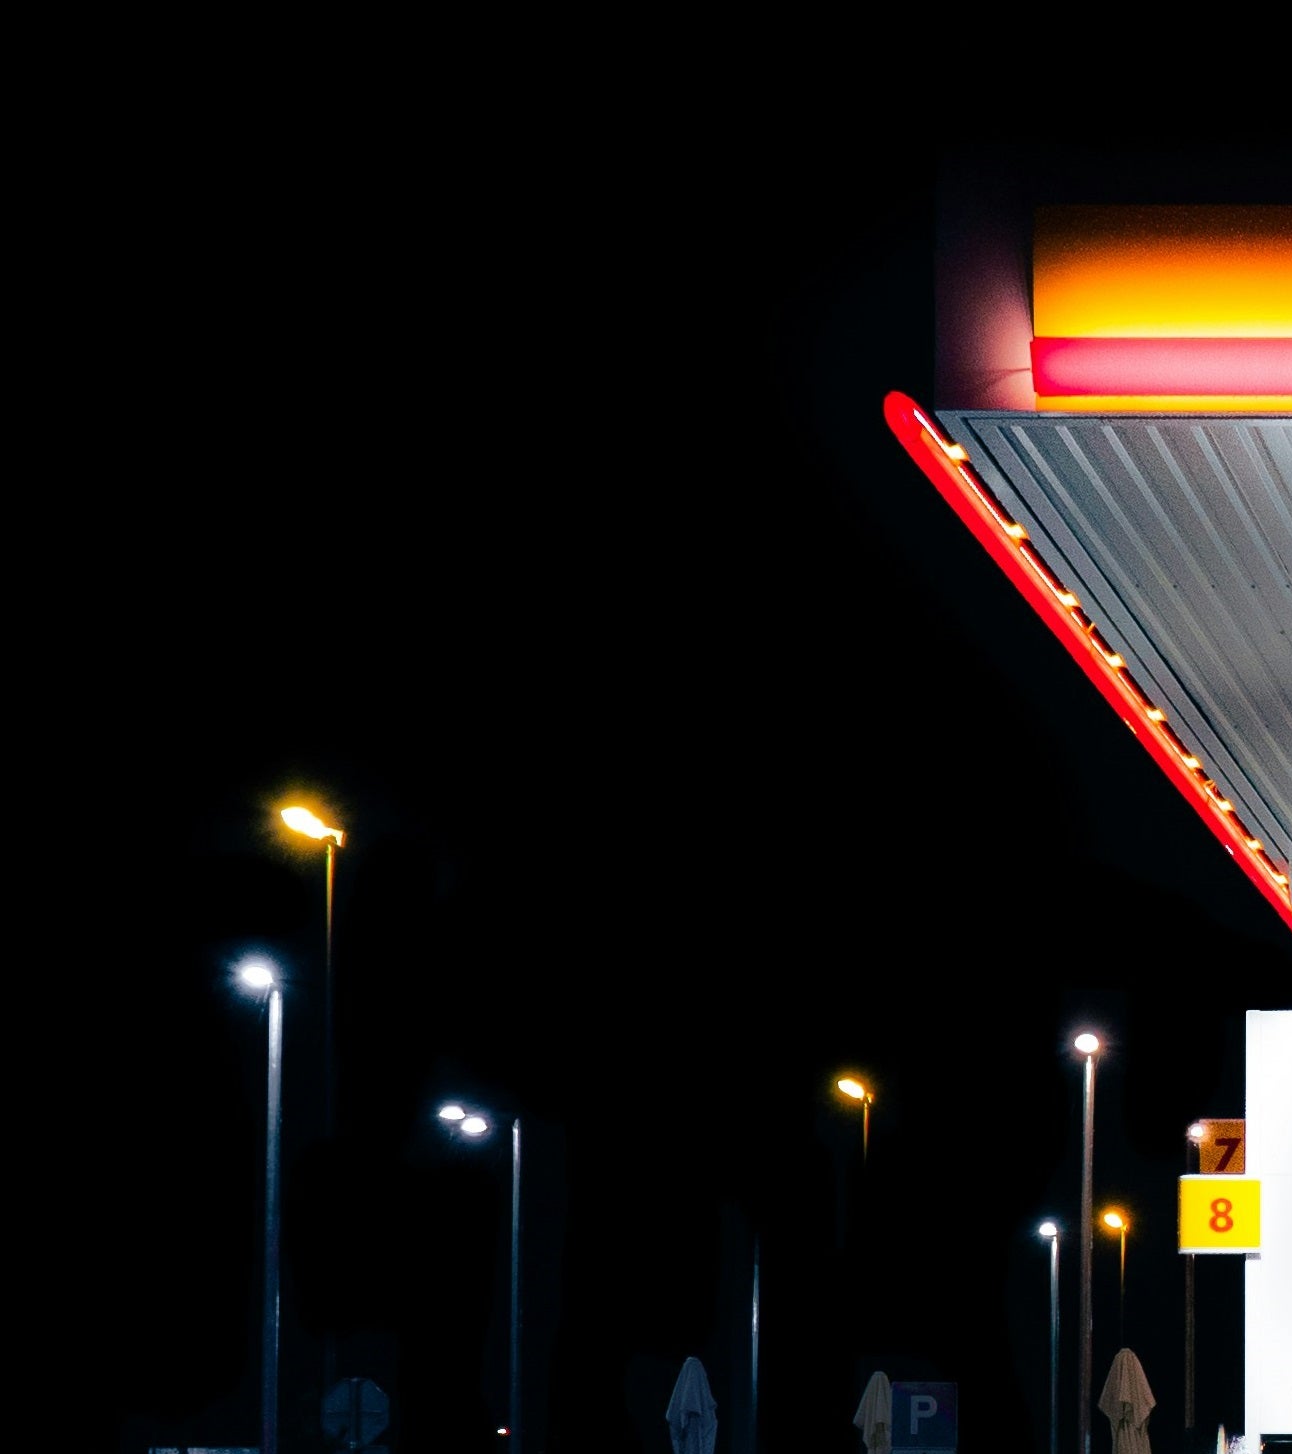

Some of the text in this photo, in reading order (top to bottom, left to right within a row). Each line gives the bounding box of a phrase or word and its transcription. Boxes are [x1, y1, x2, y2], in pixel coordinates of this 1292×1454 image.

[1215, 1138, 1241, 1172] 7
[1208, 1198, 1234, 1233] 8
[910, 1395, 938, 1435] P
